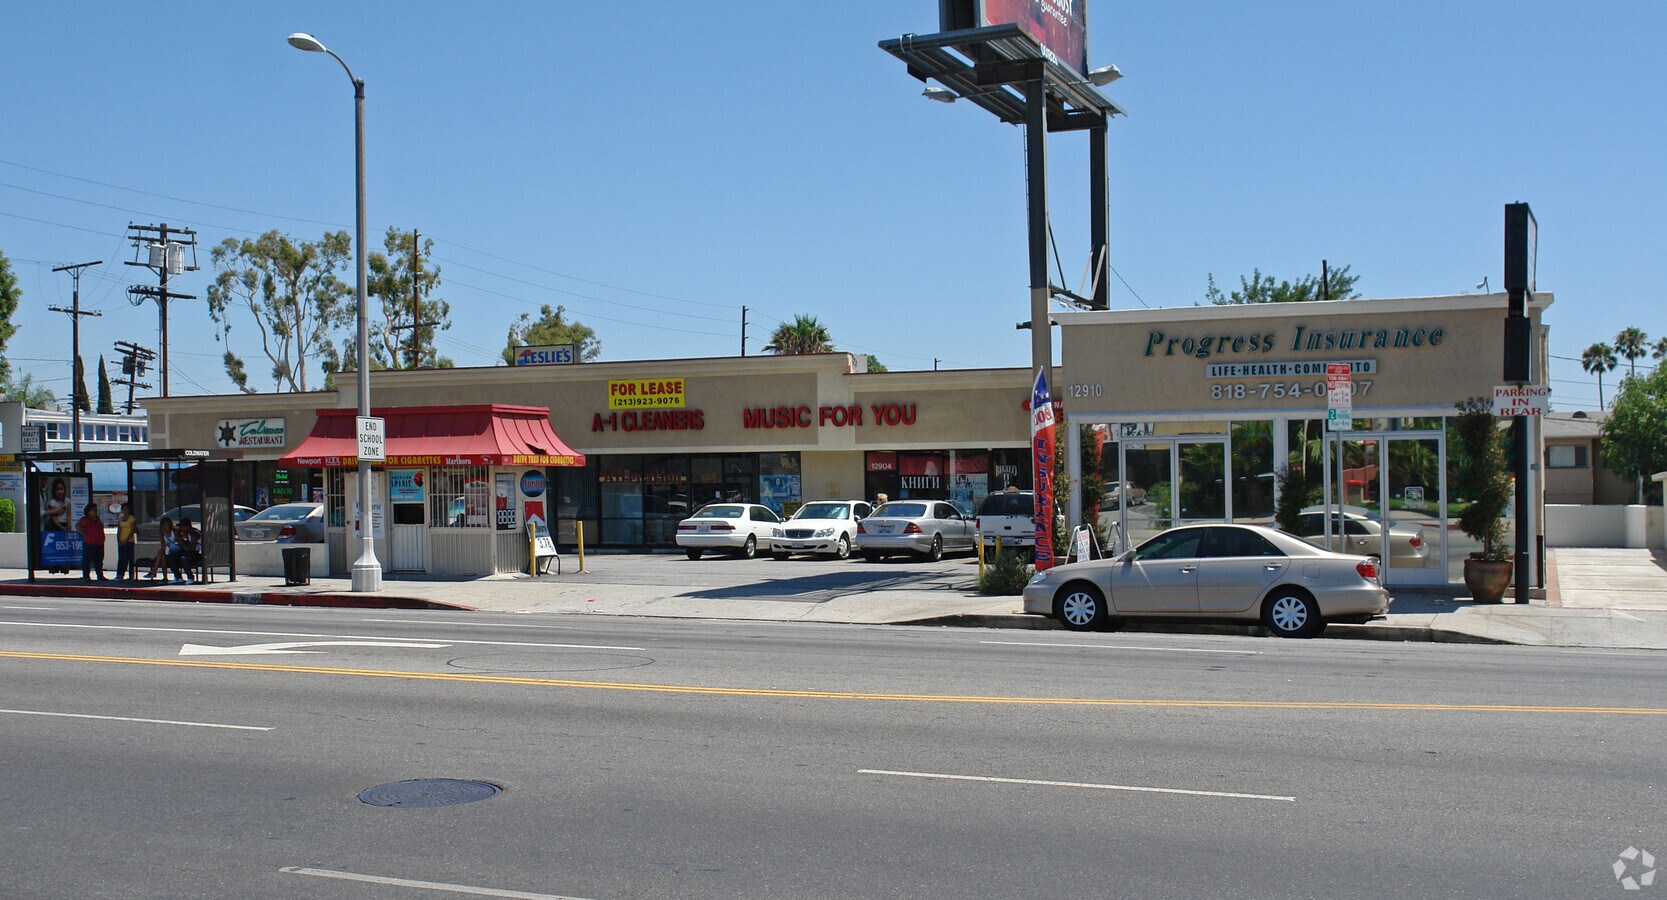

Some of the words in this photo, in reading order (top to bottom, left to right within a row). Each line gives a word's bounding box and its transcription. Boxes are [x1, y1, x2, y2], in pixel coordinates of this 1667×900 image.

[1291, 326, 1444, 351] Insurance
[1144, 332, 1275, 358] Progress
[524, 348, 571, 364] LESLIE'S
[611, 383, 637, 396] FOR
[640, 381, 683, 395] LEASE
[1069, 384, 1102, 398] 12910
[1495, 388, 1547, 397] PARKING
[613, 397, 680, 406] (213)923-9076
[1512, 398, 1529, 406] IN
[743, 406, 812, 429] MUSIC
[819, 405, 863, 427] FOR
[871, 403, 917, 426] YOU
[1330, 409, 1335, 419] 2
[1500, 407, 1542, 416] REAR
[592, 412, 618, 432] A-1
[621, 409, 705, 431] CLEANERS
[365, 421, 377, 431] END
[239, 436, 283, 445] RESTAURANT
[360, 434, 383, 444] SCHOOL
[364, 446, 379, 456] ZONE
[297, 457, 322, 466] Newport
[384, 456, 399, 465] FOR
[400, 454, 441, 464] CIGARETTES
[445, 456, 472, 465] Marlboro
[513, 454, 527, 464] DRIVE
[528, 454, 540, 464] THRU
[540, 455, 549, 464] FOR
[549, 455, 575, 464] CIGARETTES
[871, 462, 892, 470] 12904
[901, 476, 940, 489] КНИГИ
[272, 487, 294, 495] KABOB
